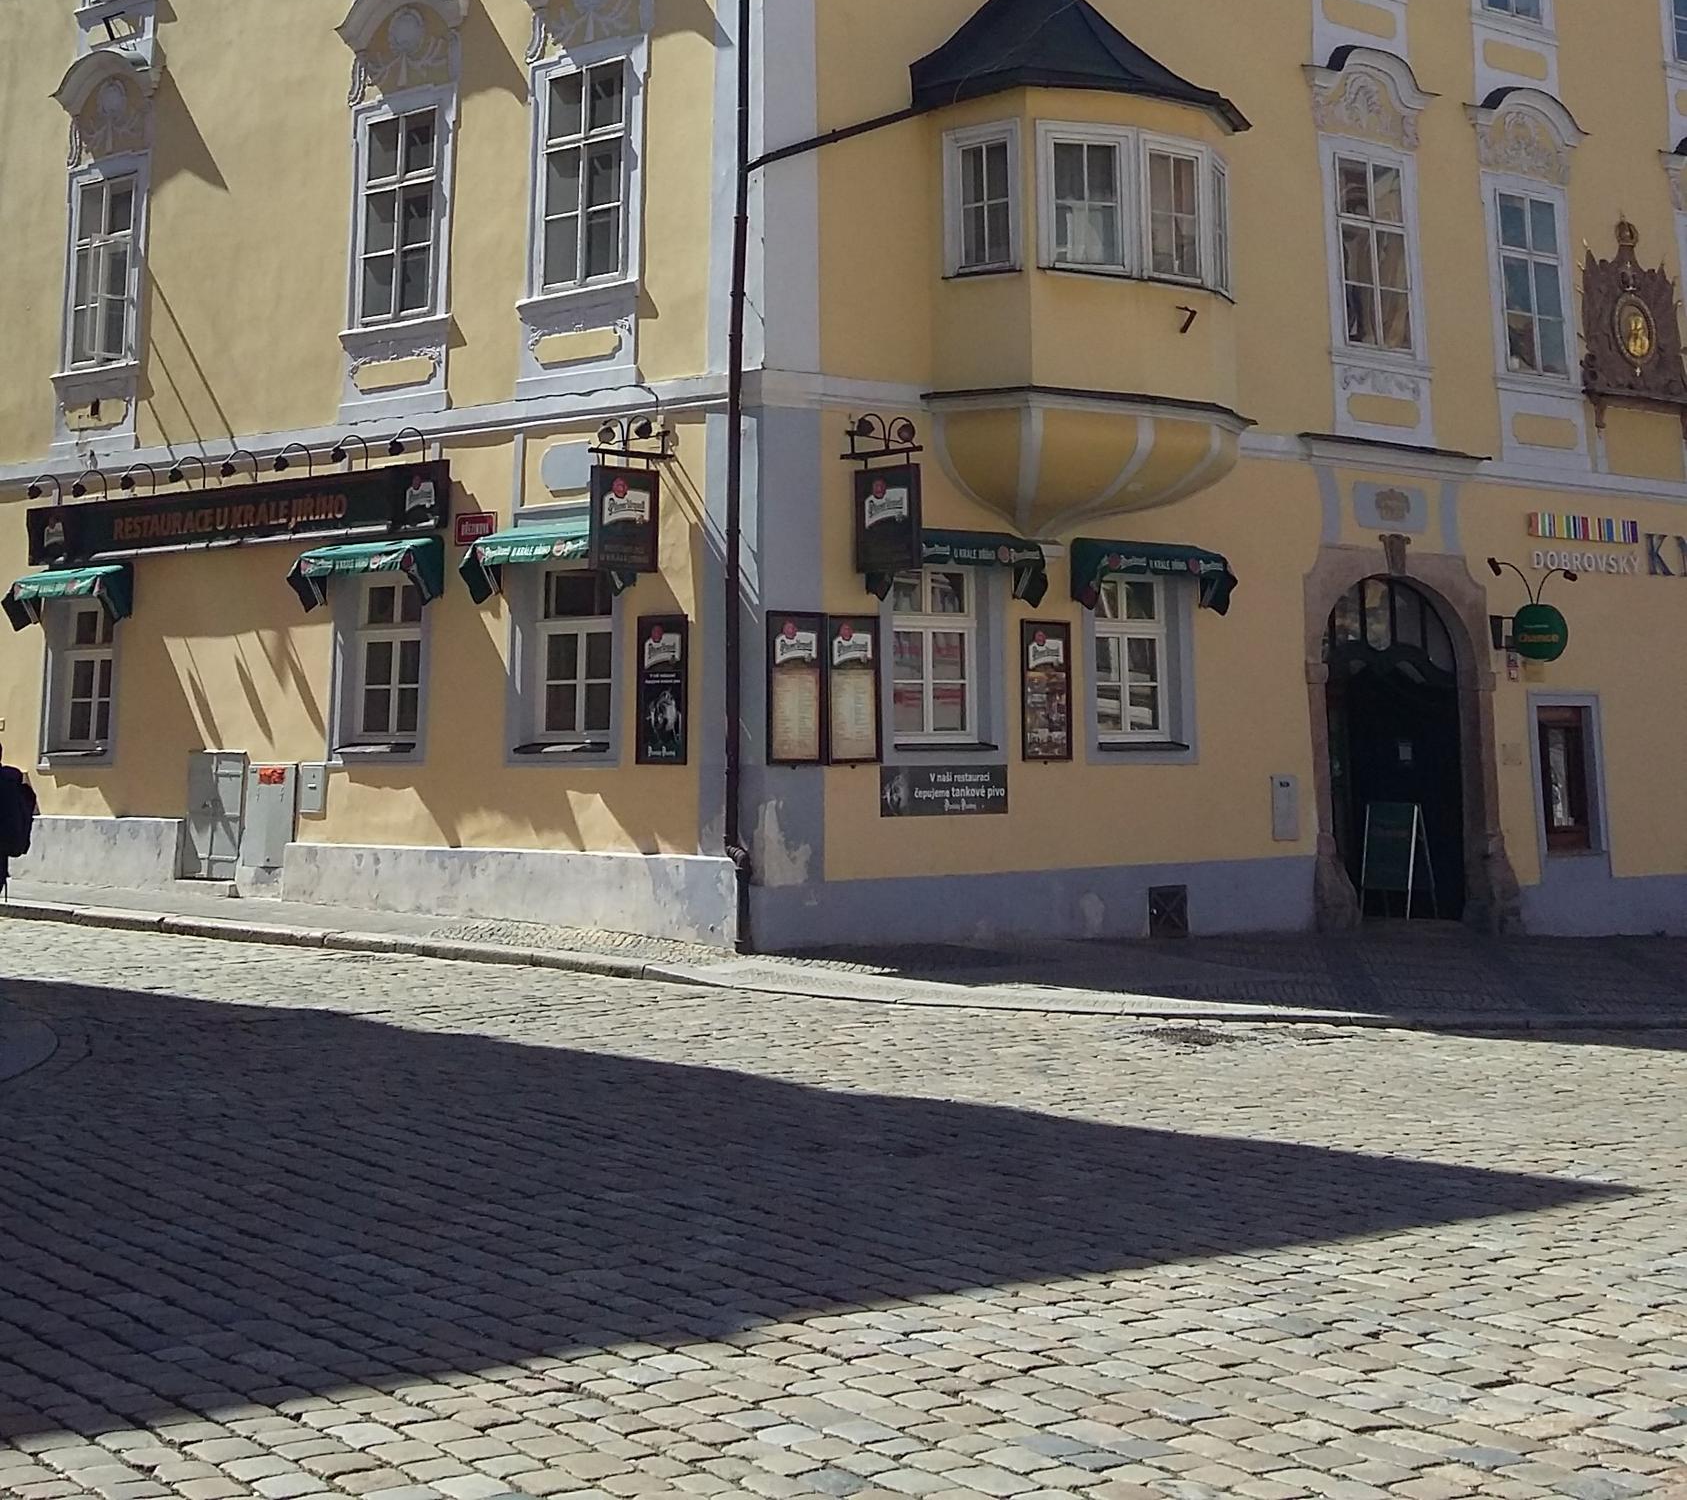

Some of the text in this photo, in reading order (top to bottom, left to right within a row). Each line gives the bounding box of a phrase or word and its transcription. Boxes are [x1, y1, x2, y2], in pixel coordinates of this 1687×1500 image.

[113, 508, 214, 541] RESTAURACE
[215, 507, 229, 531] U
[929, 772, 936, 782] V
[953, 772, 990, 782] restauraci
[914, 785, 1005, 800] čepujeme tankové pivo
